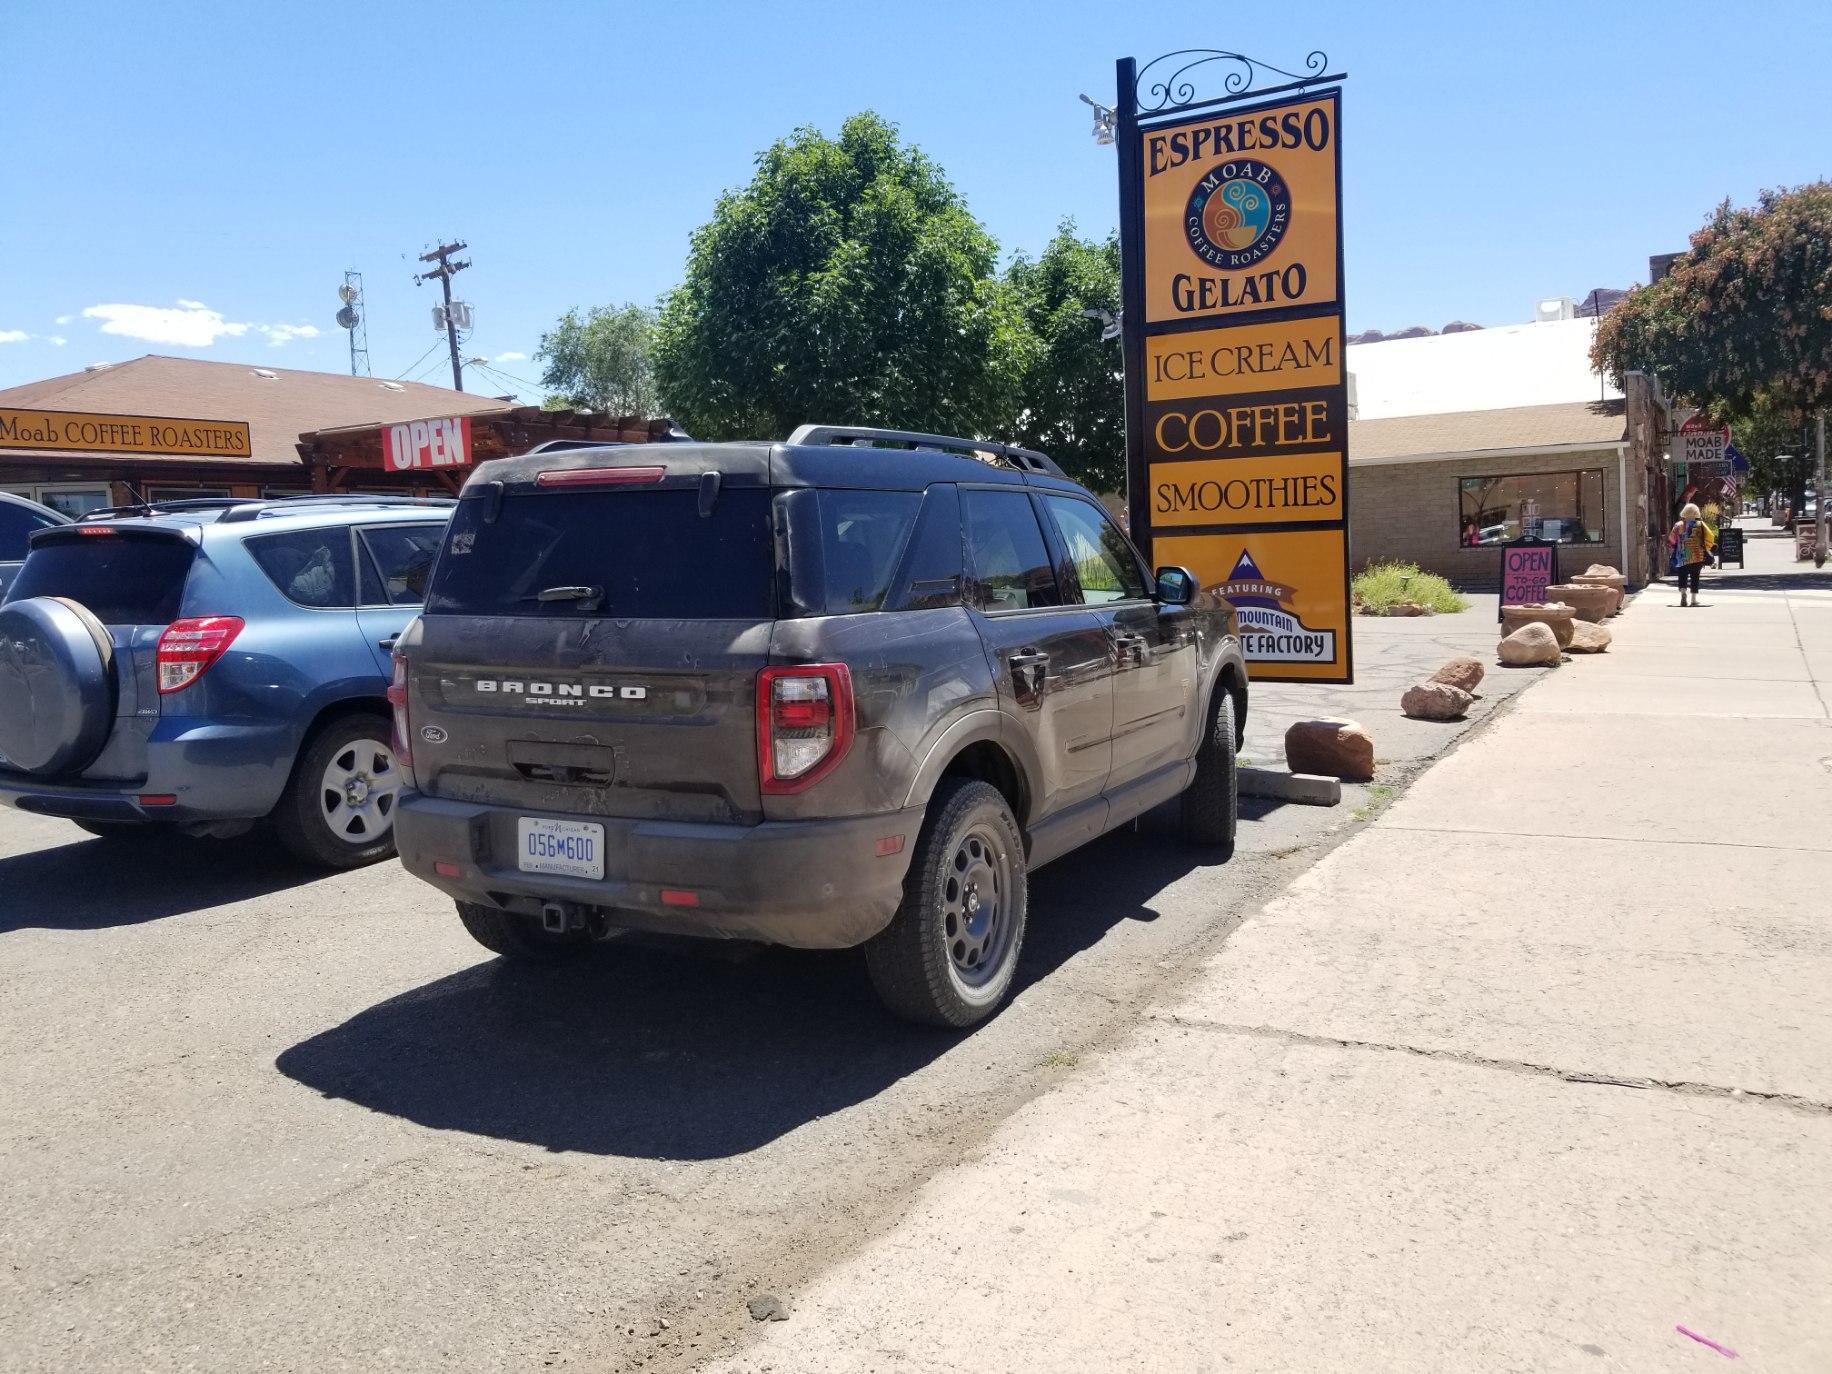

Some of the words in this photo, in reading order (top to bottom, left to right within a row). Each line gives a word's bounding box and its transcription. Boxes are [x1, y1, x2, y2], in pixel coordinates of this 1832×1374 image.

[1149, 107, 1329, 177] ESPRESSO
[1201, 162, 1272, 193] MOAB
[1190, 216, 1224, 264] COFFEE
[1231, 203, 1286, 264] ROASTERS
[1172, 262, 1307, 312] GELATO
[1154, 351, 1206, 383] ICE
[1210, 337, 1333, 376] CREAM
[0, 417, 59, 443] Moab
[65, 421, 144, 446] COFFEE
[149, 426, 244, 450] ROASTERS
[1155, 400, 1331, 453] COFFEE
[391, 417, 464, 469] OPEN
[1686, 436, 1722, 448] MOAB
[1686, 449, 1722, 460] MADE
[1157, 475, 1337, 513] SMOOTHIES
[1509, 551, 1549, 571] OPEN
[1211, 583, 1282, 596] FEATURING
[1506, 585, 1549, 602] COFFEE
[1258, 634, 1325, 657] FACTORY
[477, 680, 646, 699] BRONCO
[525, 697, 587, 706] SPORT
[528, 832, 593, 861] 056M600
